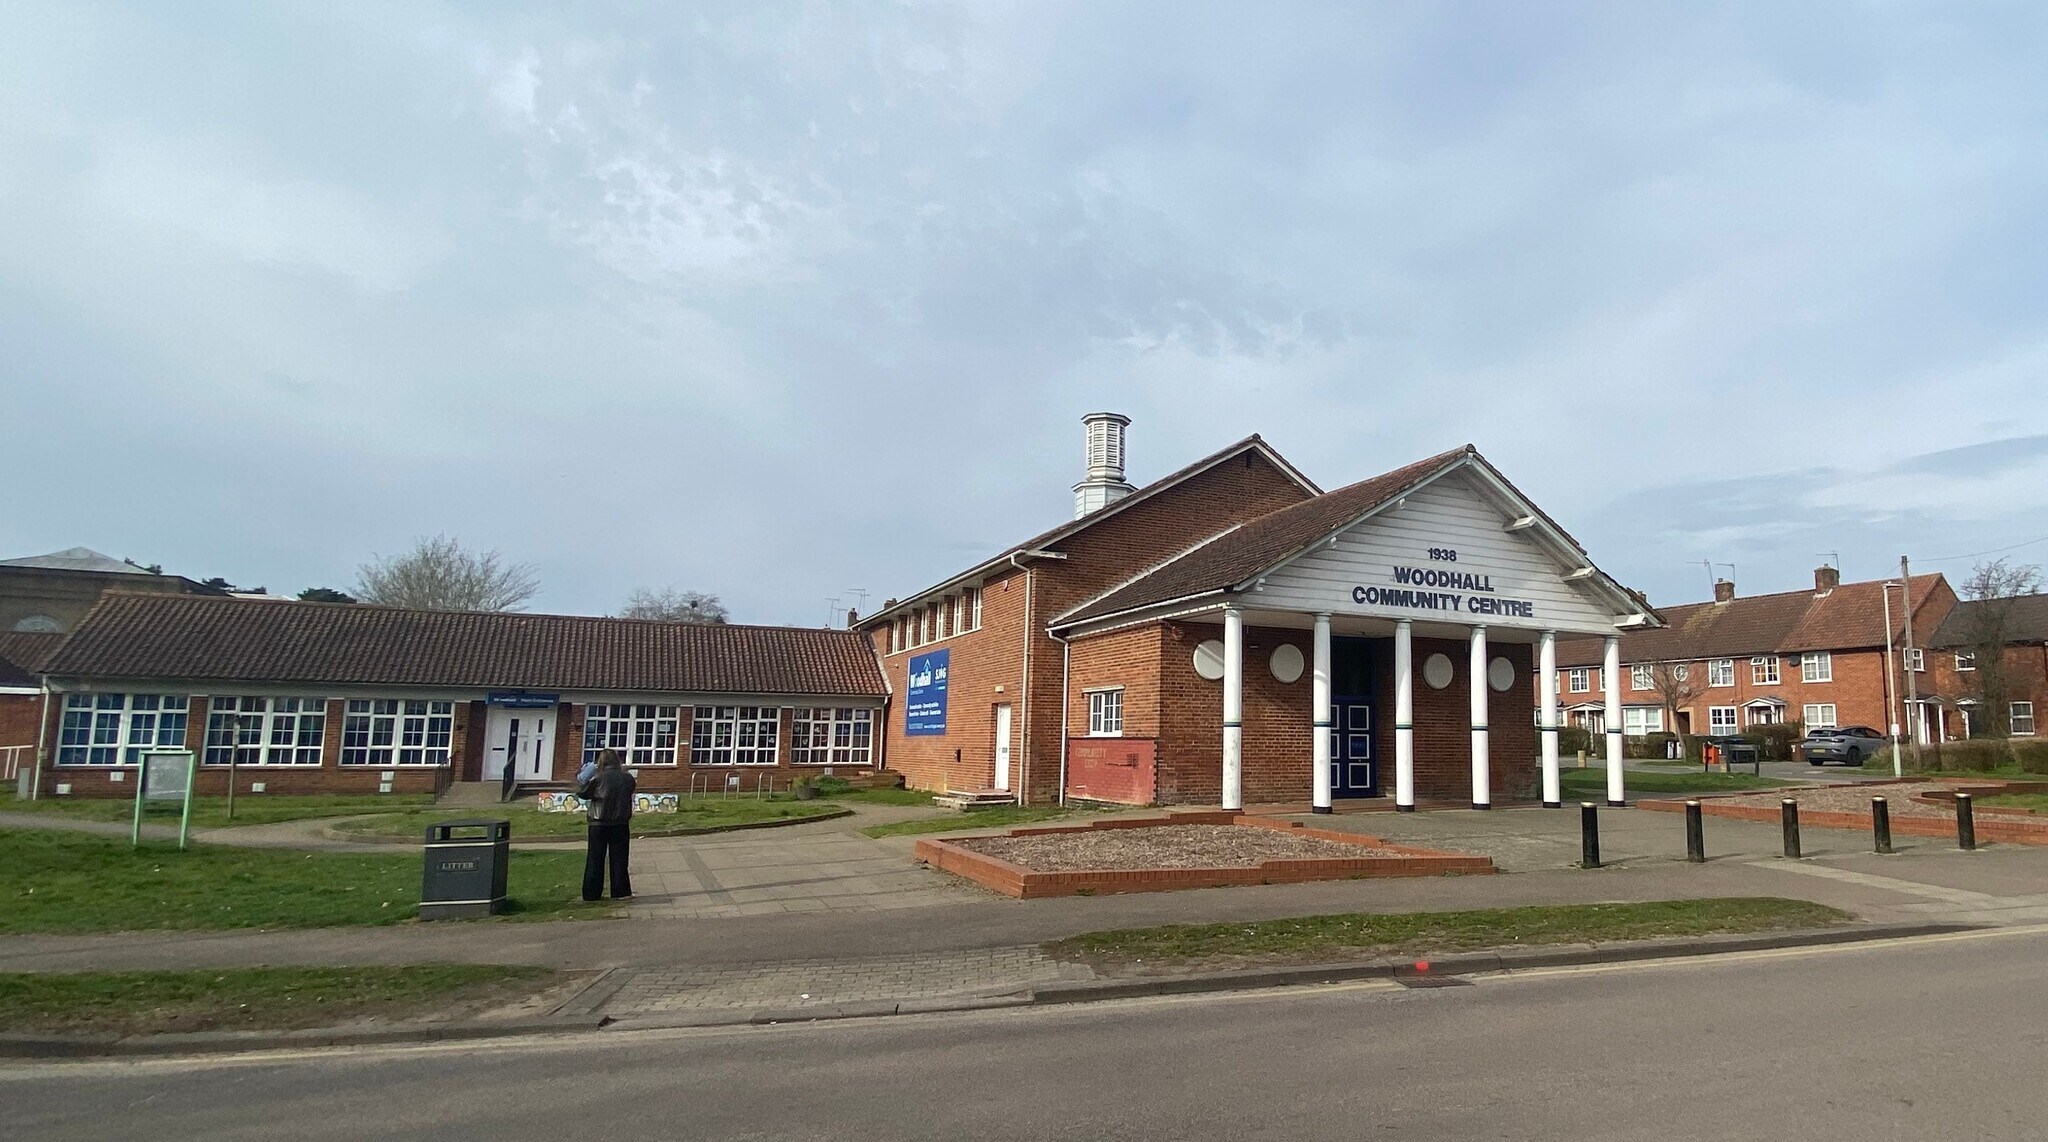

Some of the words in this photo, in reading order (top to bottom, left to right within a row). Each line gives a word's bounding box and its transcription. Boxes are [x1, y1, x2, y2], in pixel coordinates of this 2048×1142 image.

[1427, 547, 1457, 562] 1938
[1393, 566, 1495, 592] WOODHALL
[1352, 586, 1462, 611] COMMUNITY
[1467, 596, 1533, 617] CENTRE
[441, 861, 474, 870] LITTER
